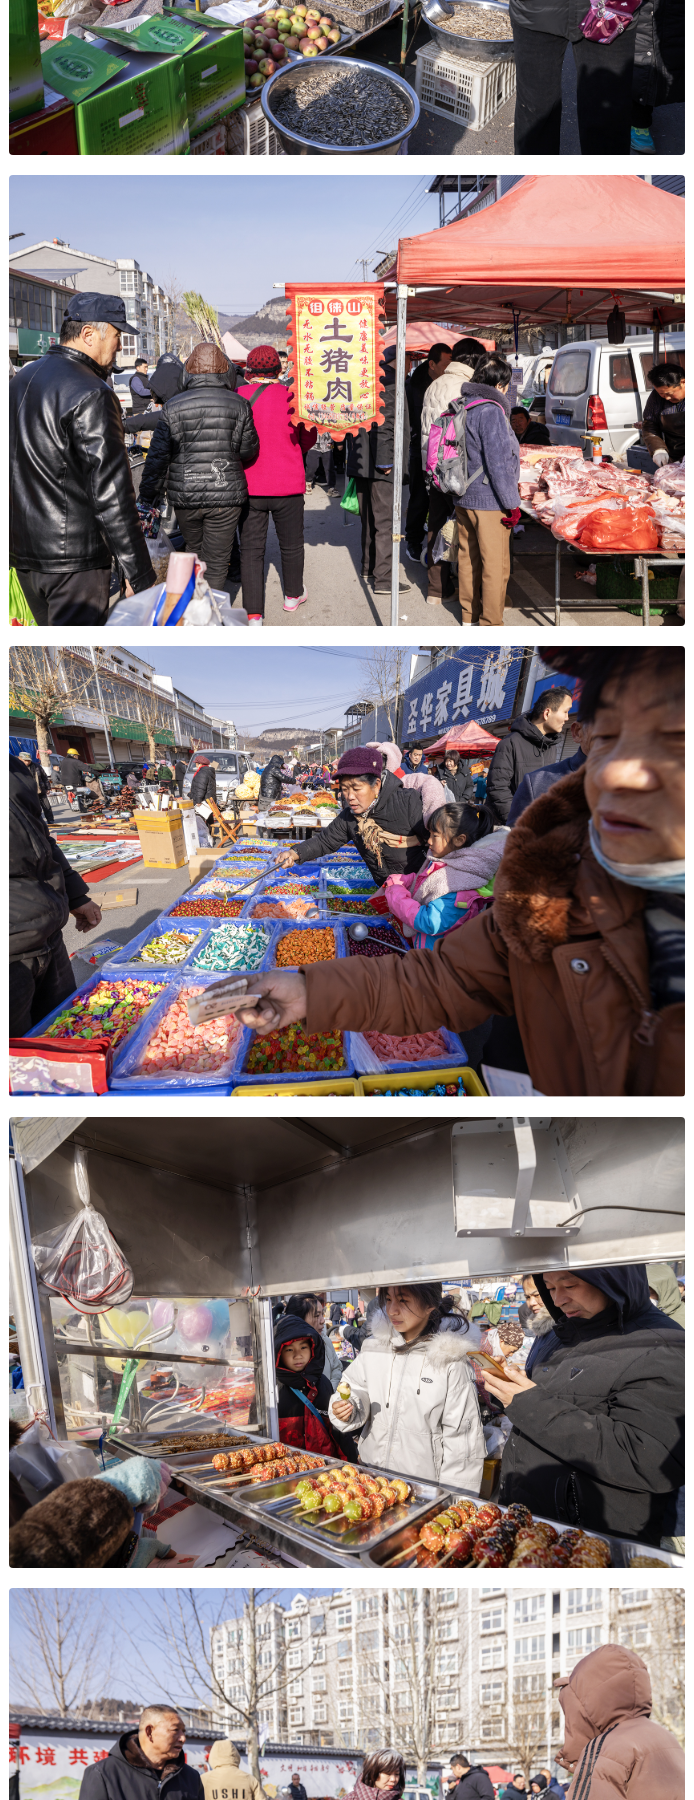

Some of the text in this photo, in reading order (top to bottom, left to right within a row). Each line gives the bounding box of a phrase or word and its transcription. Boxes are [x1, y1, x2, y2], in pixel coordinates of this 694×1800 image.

[310, 302, 361, 314] 徂徕山
[319, 317, 354, 402] 土猪肉
[358, 319, 371, 400] 健康美味更放心
[407, 647, 512, 734] 圣华家具城
[9, 1746, 57, 1766] 环境
[212, 1788, 246, 1800] USHI
